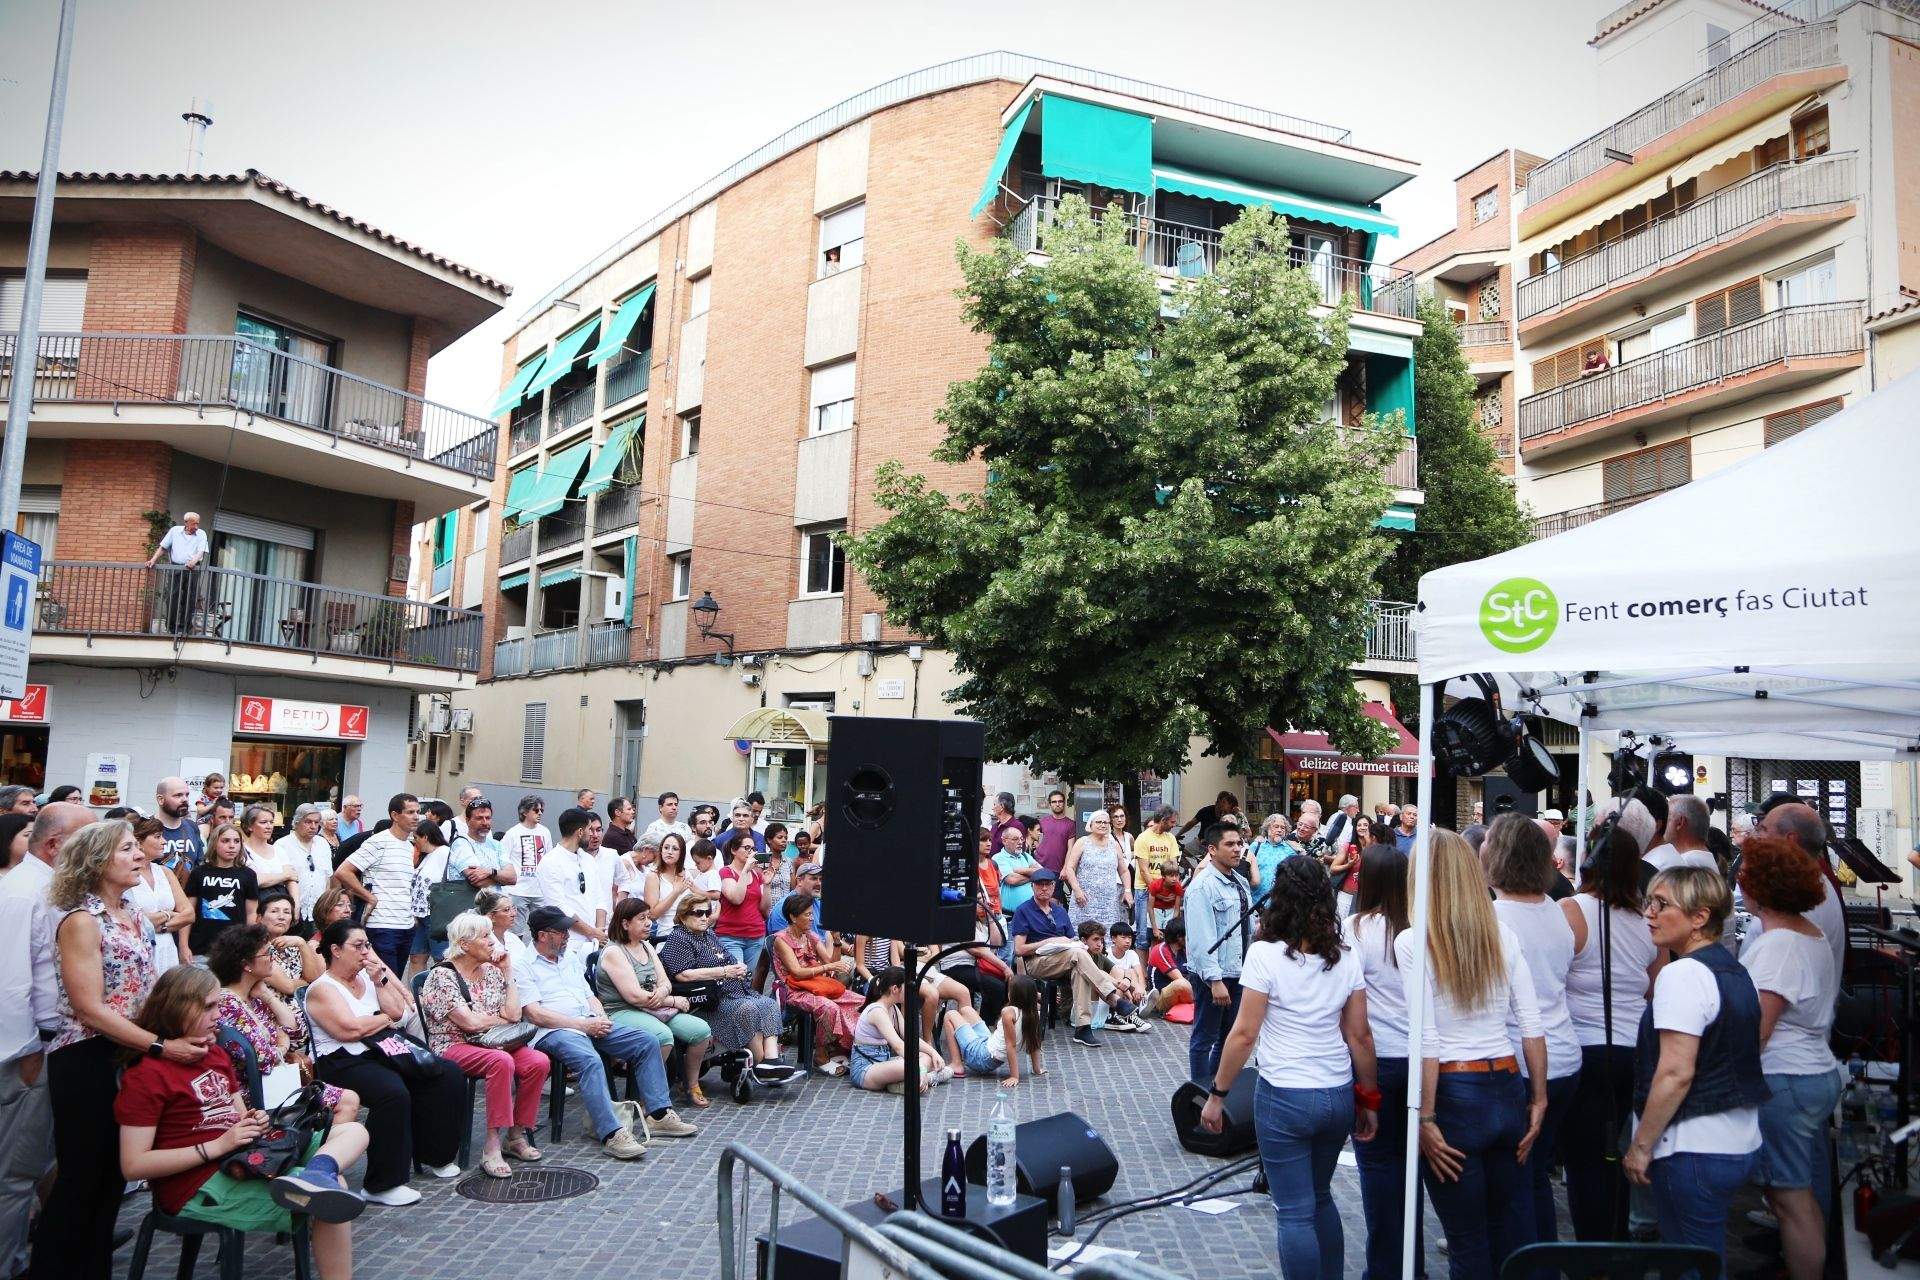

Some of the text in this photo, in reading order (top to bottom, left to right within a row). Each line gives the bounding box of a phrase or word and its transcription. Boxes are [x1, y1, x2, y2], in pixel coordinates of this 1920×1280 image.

[1488, 589, 1548, 628] StC
[1566, 585, 1868, 622] Fent comerç fas Ciutat
[283, 708, 323, 721] PETIT
[1300, 757, 1339, 770] delizie
[1342, 760, 1390, 773] gourmet
[521, 836, 536, 866] MARVEL
[203, 876, 240, 889] NASA
[688, 995, 708, 1003] YDER
